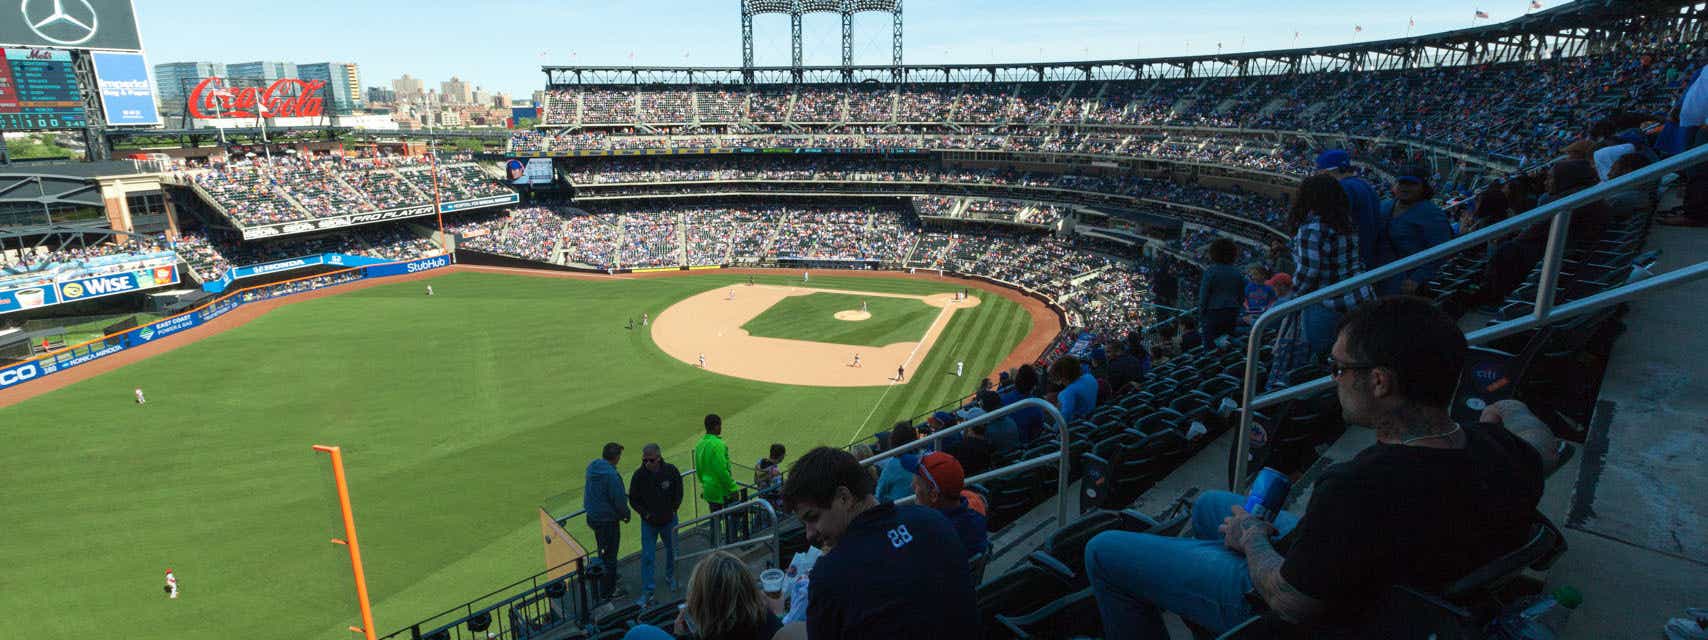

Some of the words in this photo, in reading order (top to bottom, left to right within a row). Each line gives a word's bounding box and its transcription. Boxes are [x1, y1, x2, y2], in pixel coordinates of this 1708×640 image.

[188, 76, 326, 119] Coca-Cola
[351, 214, 382, 224] PRO
[382, 206, 433, 219] PLAYER
[263, 259, 305, 270] HONDA
[407, 257, 445, 272] StubHub
[83, 275, 133, 295] WISE
[156, 320, 172, 329] EAST
[172, 314, 191, 324] COAST
[887, 524, 913, 548] 28
